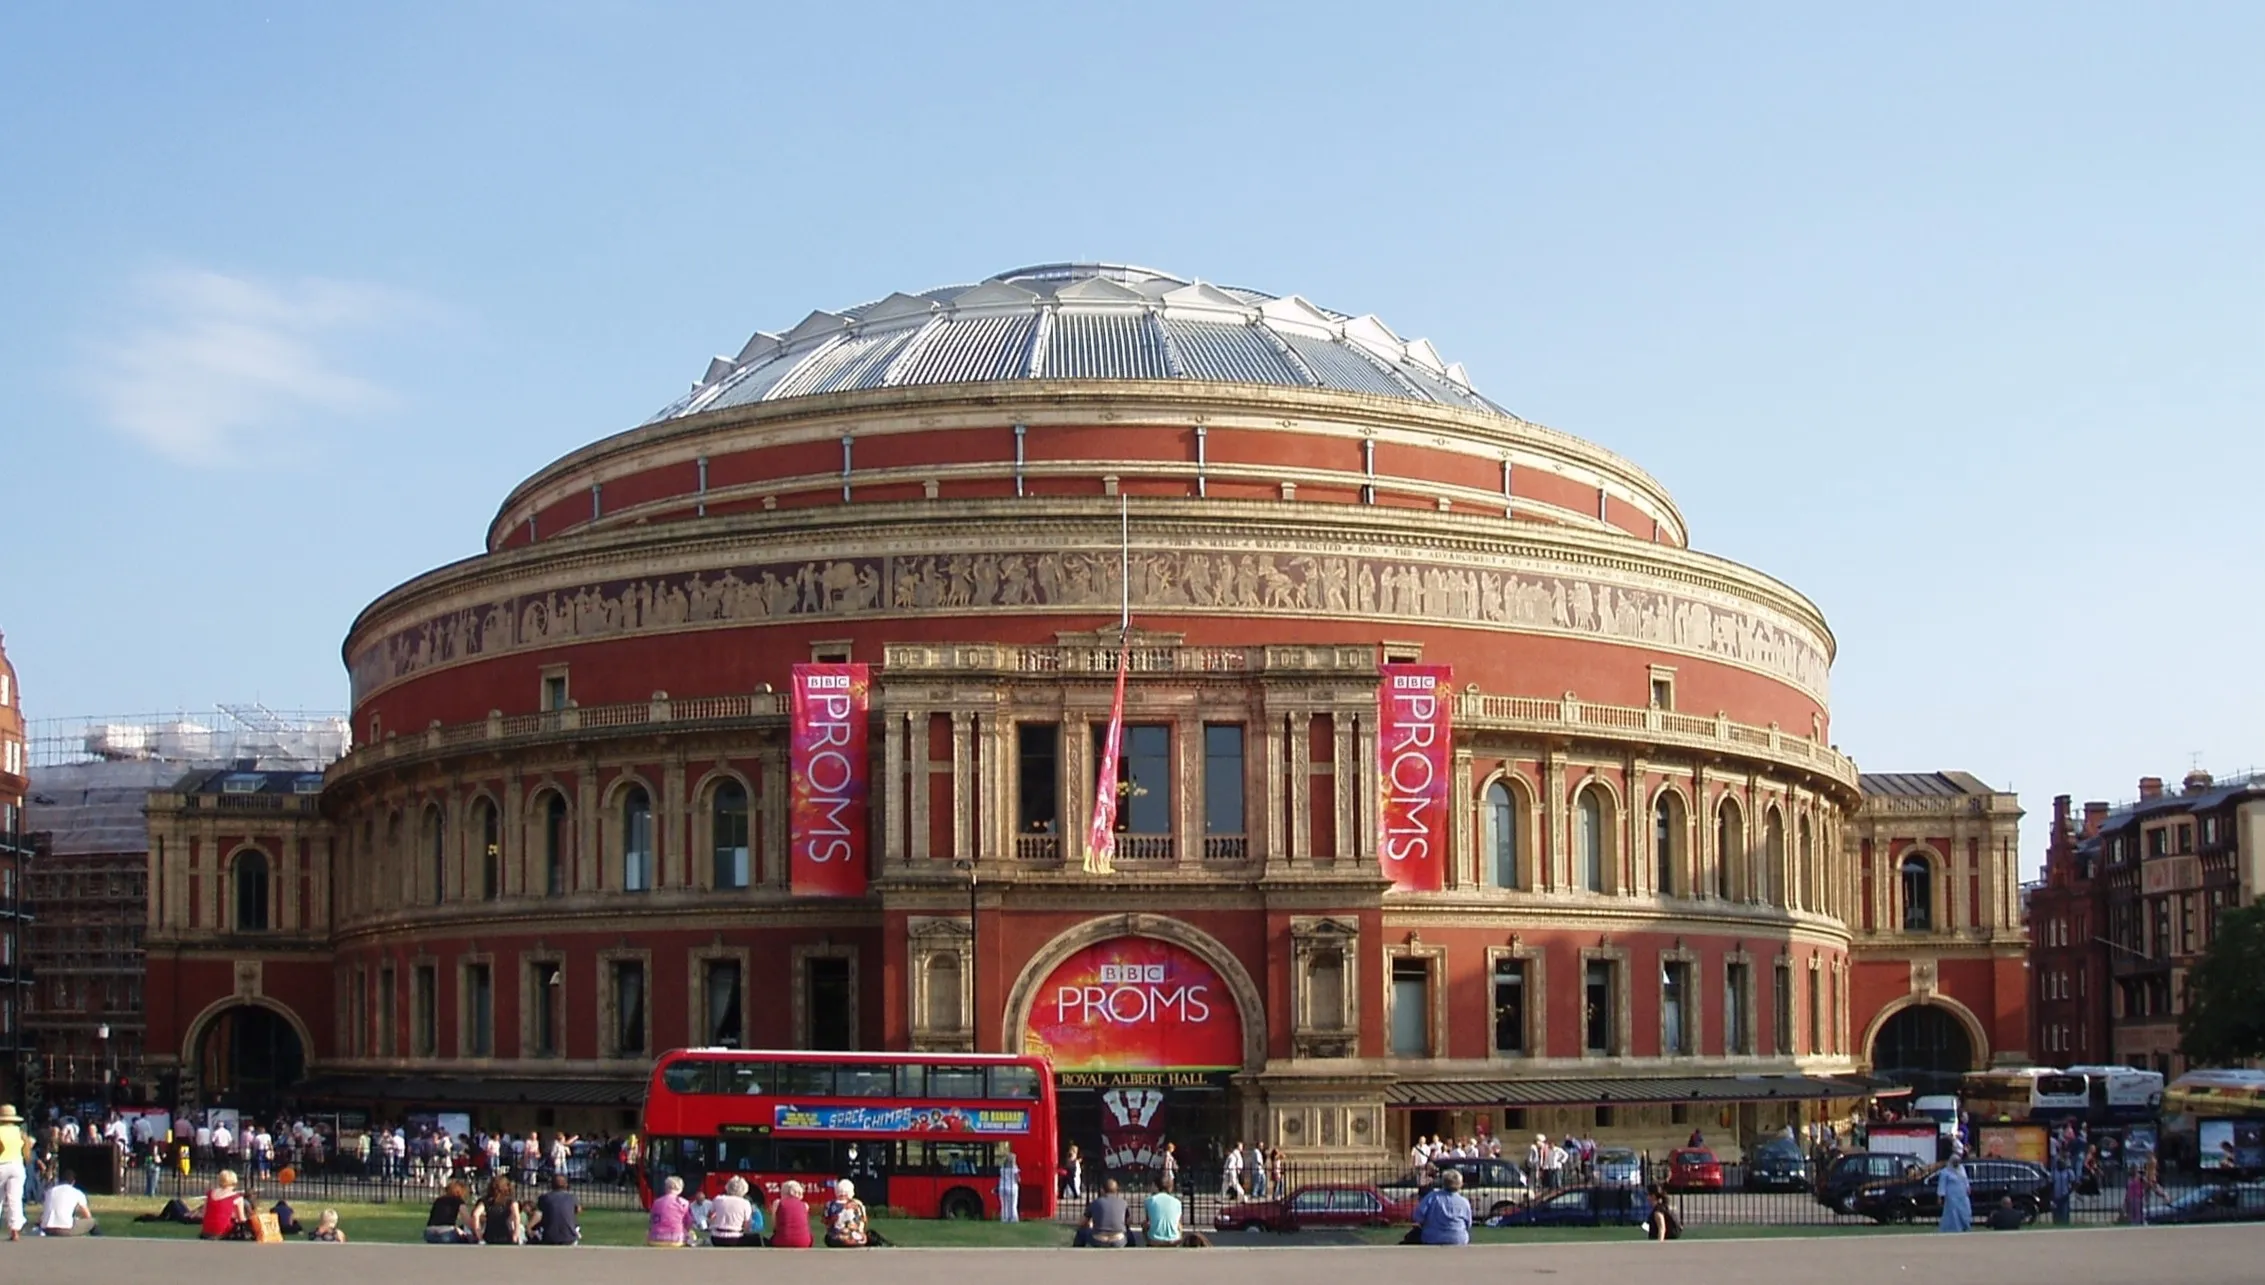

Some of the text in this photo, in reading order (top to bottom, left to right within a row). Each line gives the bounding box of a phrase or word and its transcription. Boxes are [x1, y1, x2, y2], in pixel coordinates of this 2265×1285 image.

[809, 676, 849, 688] BBC
[1395, 676, 1435, 688] BBC
[808, 695, 851, 862] PROMS
[1388, 695, 1436, 861] PROMS
[1103, 966, 1163, 981] BBC
[1058, 986, 1209, 1023] PROMS
[1062, 1072, 1208, 1086] ROYAL ALBERT HALL
[829, 1108, 866, 1129] SPACE
[863, 1107, 912, 1130] CHIMPS
